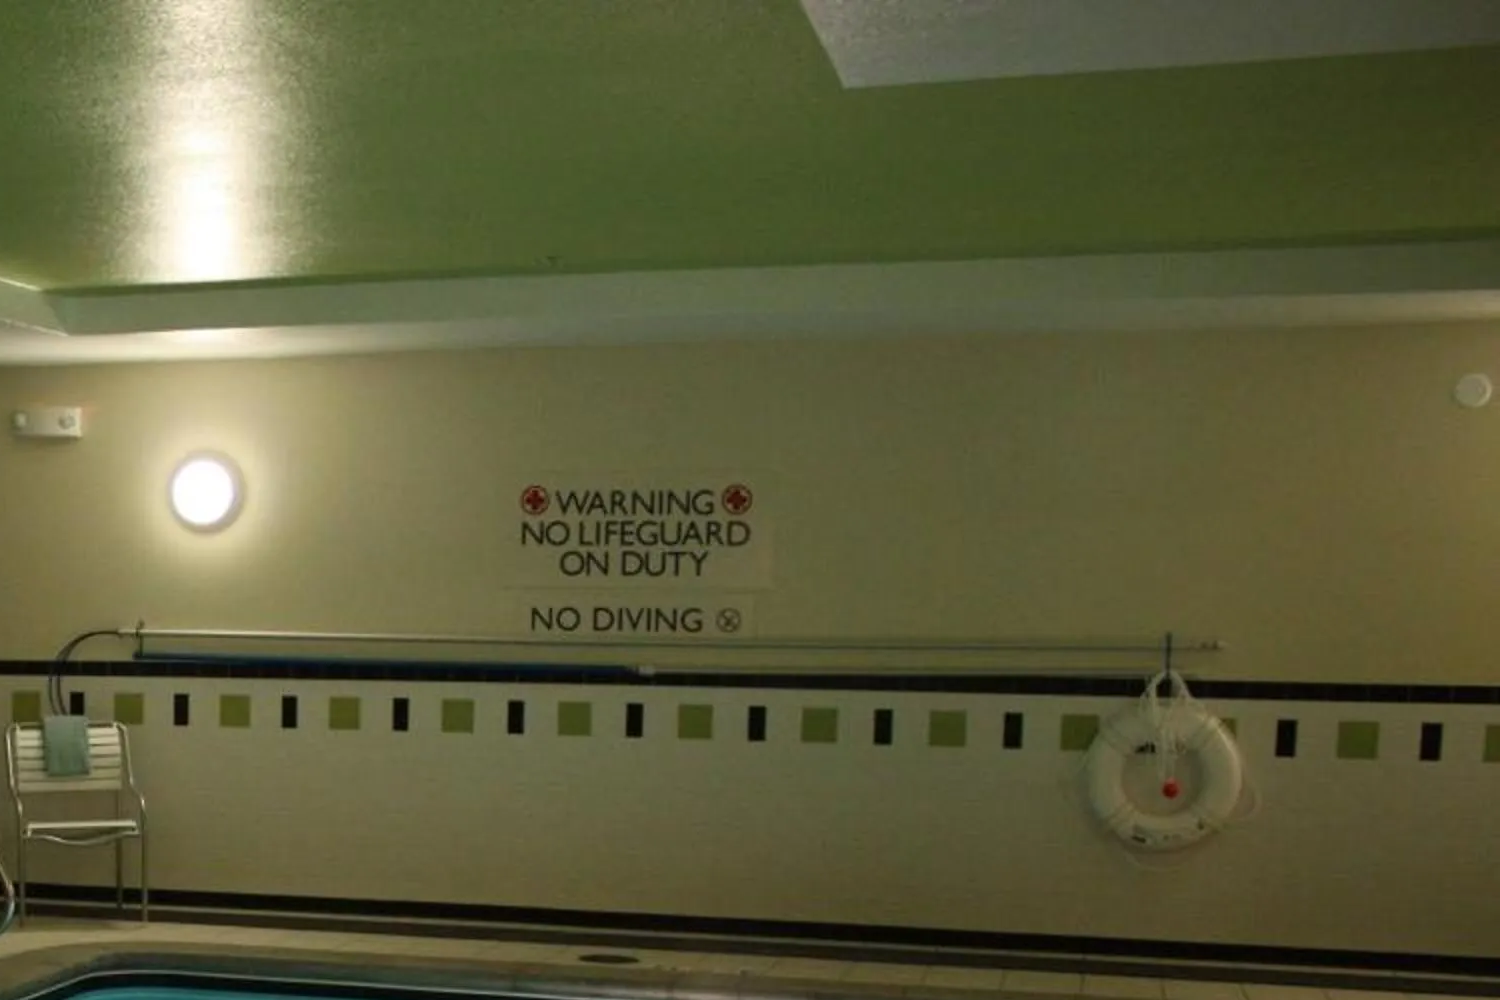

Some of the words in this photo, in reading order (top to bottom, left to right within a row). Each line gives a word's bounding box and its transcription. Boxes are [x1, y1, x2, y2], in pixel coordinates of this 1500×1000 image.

[555, 489, 715, 516] WARNING
[521, 521, 571, 546] NO
[578, 520, 751, 547] LIFEGUARD
[560, 550, 609, 577] ON
[621, 551, 708, 577] DUTY
[531, 606, 581, 632] NO
[593, 606, 704, 633] DIVING
